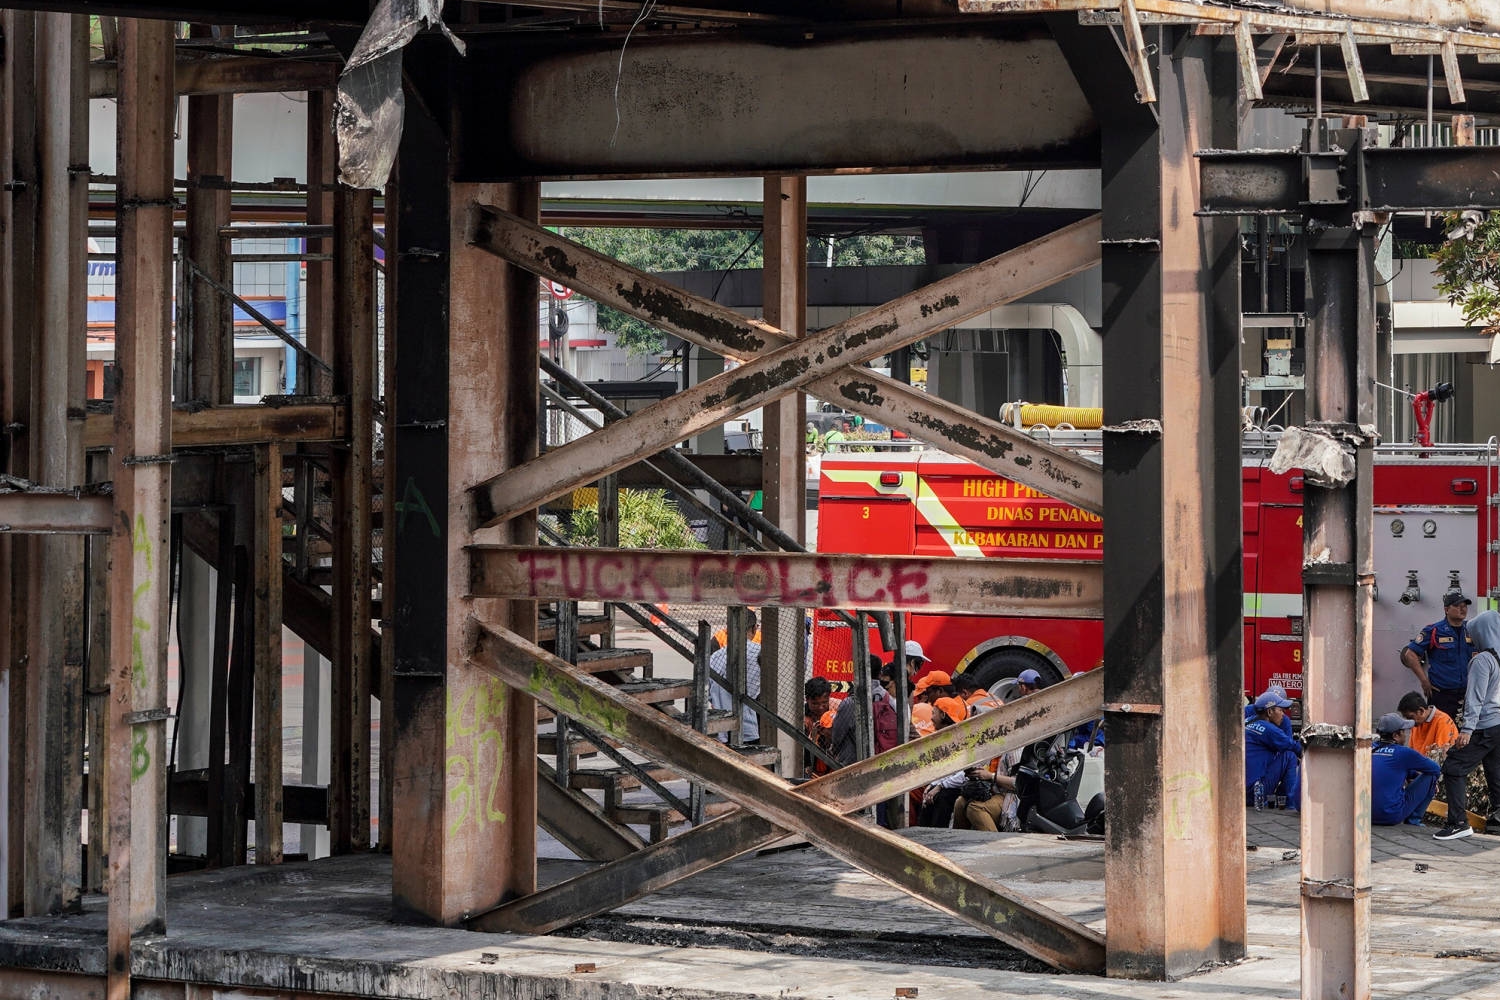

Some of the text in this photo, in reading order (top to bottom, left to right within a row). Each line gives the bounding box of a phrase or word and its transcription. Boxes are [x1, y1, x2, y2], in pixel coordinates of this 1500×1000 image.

[88, 262, 116, 276] rm
[963, 479, 1007, 498] HIGH
[862, 506, 870, 519] 3
[987, 506, 1034, 521] DINAS
[1295, 514, 1304, 528] 4
[953, 531, 1049, 547] KEBAKARAN
[1054, 534, 1088, 549] DAN
[518, 551, 932, 606] FUCK POLICE
[1293, 649, 1301, 662] 9
[826, 660, 839, 673] FE
